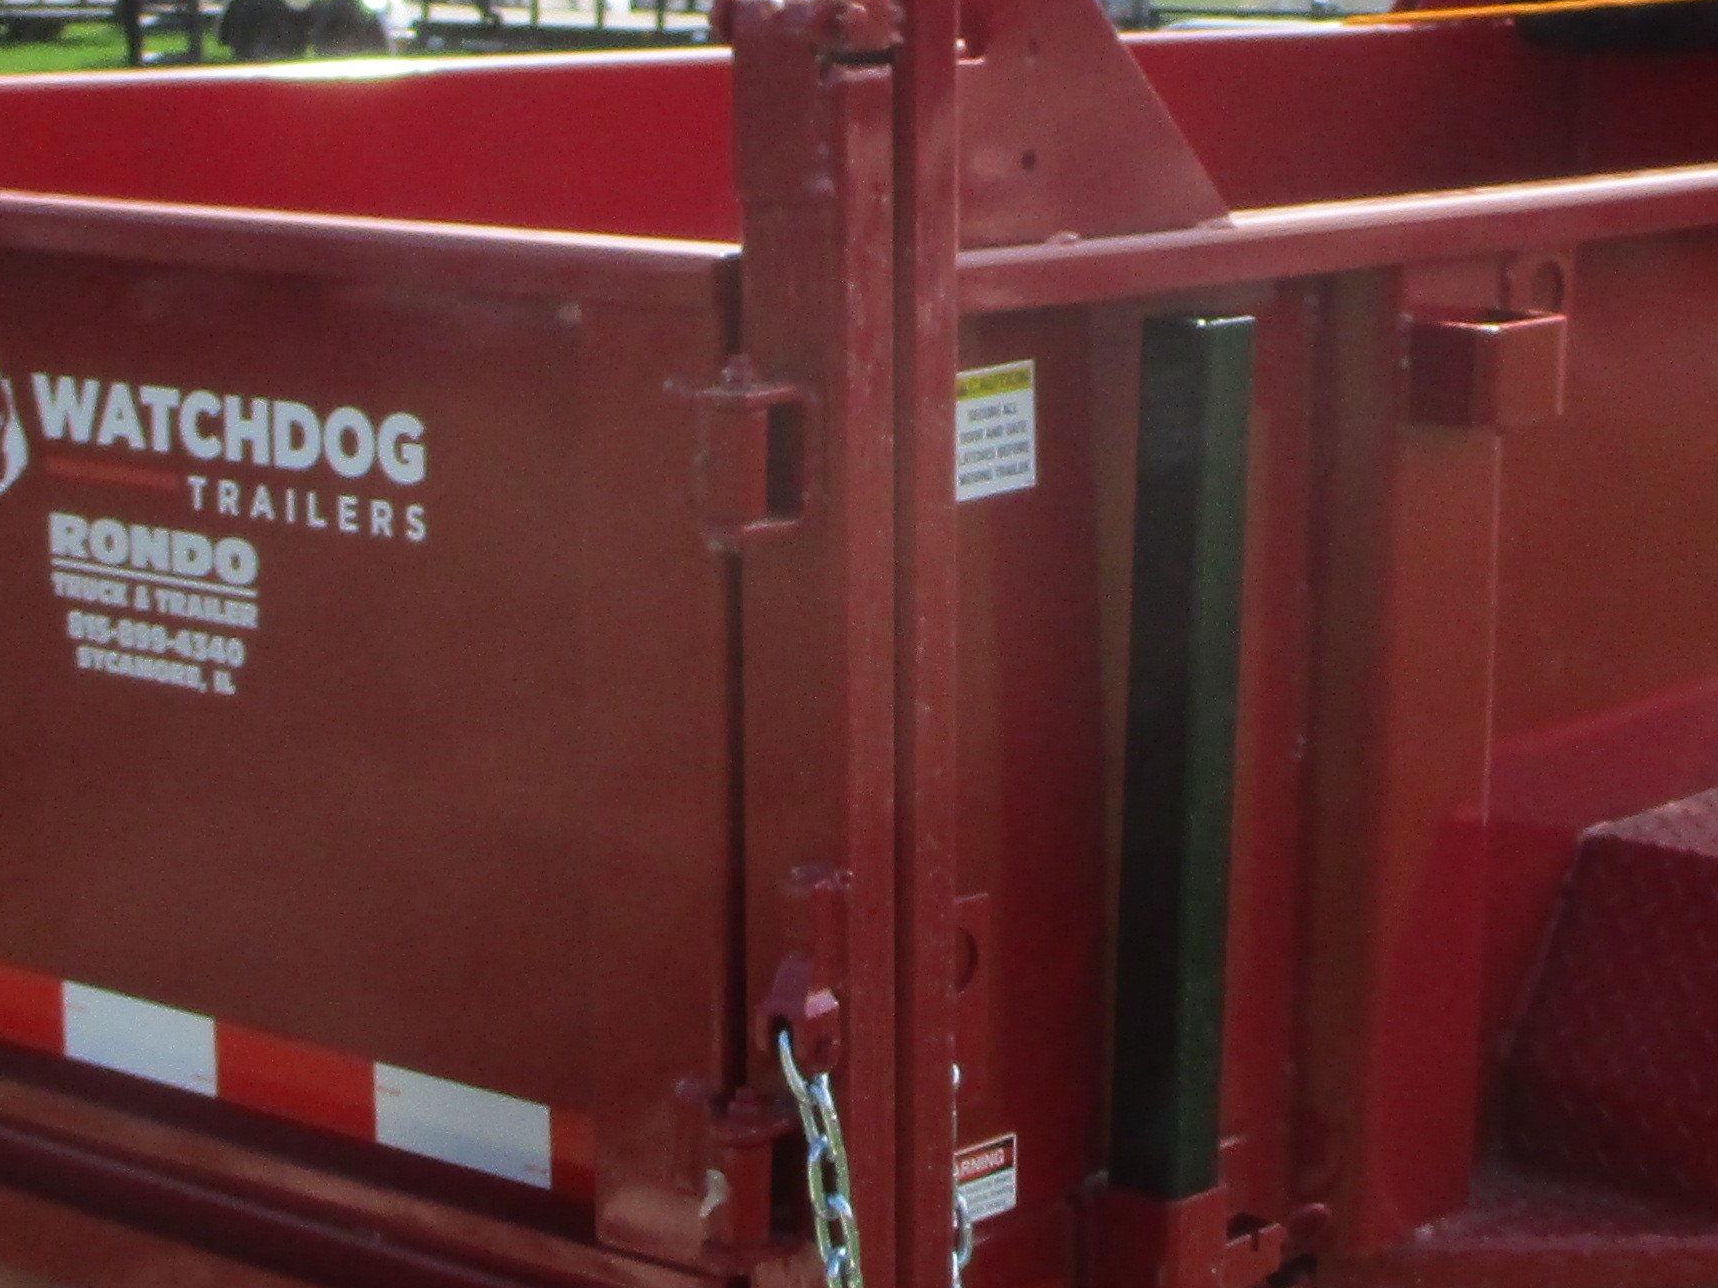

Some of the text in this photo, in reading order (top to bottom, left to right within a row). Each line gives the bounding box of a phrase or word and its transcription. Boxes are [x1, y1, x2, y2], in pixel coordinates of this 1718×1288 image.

[32, 372, 426, 484] WATCHDOG
[188, 475, 426, 541] TRAILERS
[49, 512, 260, 584] RONDO
[51, 572, 128, 607] TRUCK
[155, 588, 259, 628] TRAILER
